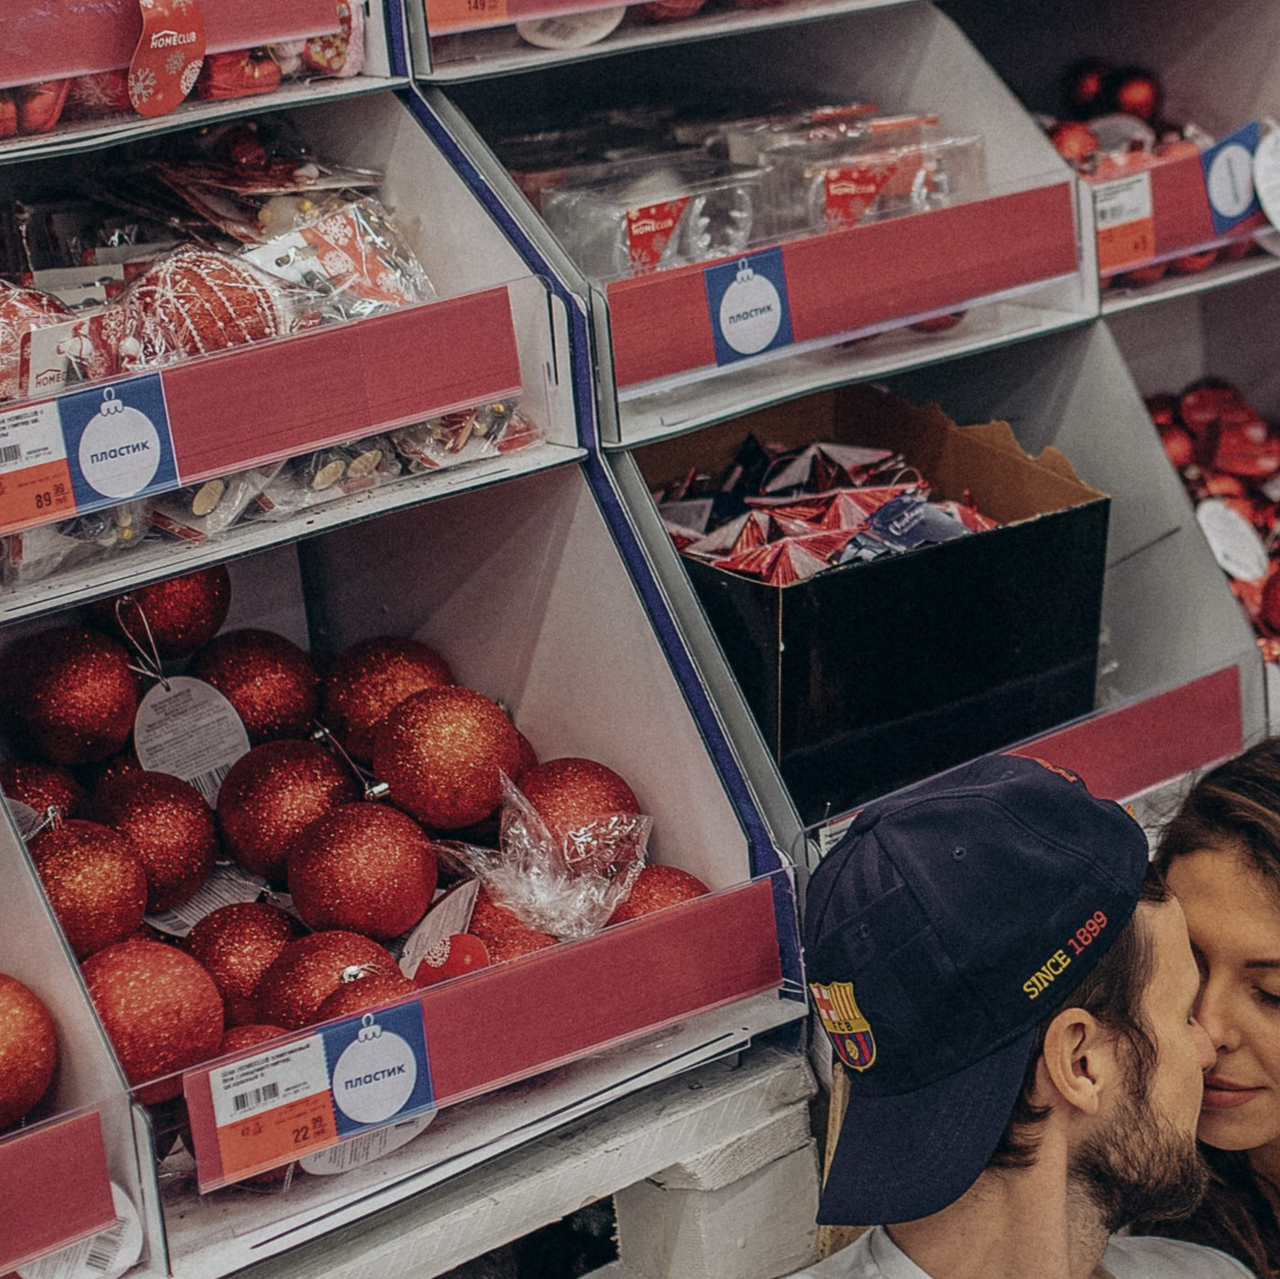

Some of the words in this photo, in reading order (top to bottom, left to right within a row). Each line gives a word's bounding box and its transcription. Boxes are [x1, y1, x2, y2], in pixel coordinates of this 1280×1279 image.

[150, 29, 197, 49] HOMECLUB
[631, 218, 673, 236] HOMECLUB
[729, 303, 773, 325] пластик
[35, 369, 66, 388] HOMEC
[90, 440, 150, 464] пластик
[34, 491, 52, 509] 89
[1022, 949, 1072, 1000] SINCE
[1067, 910, 1108, 956] 1899
[832, 1021, 853, 1032] FCB
[344, 1063, 406, 1091] пластик
[292, 1126, 310, 1144] 22
